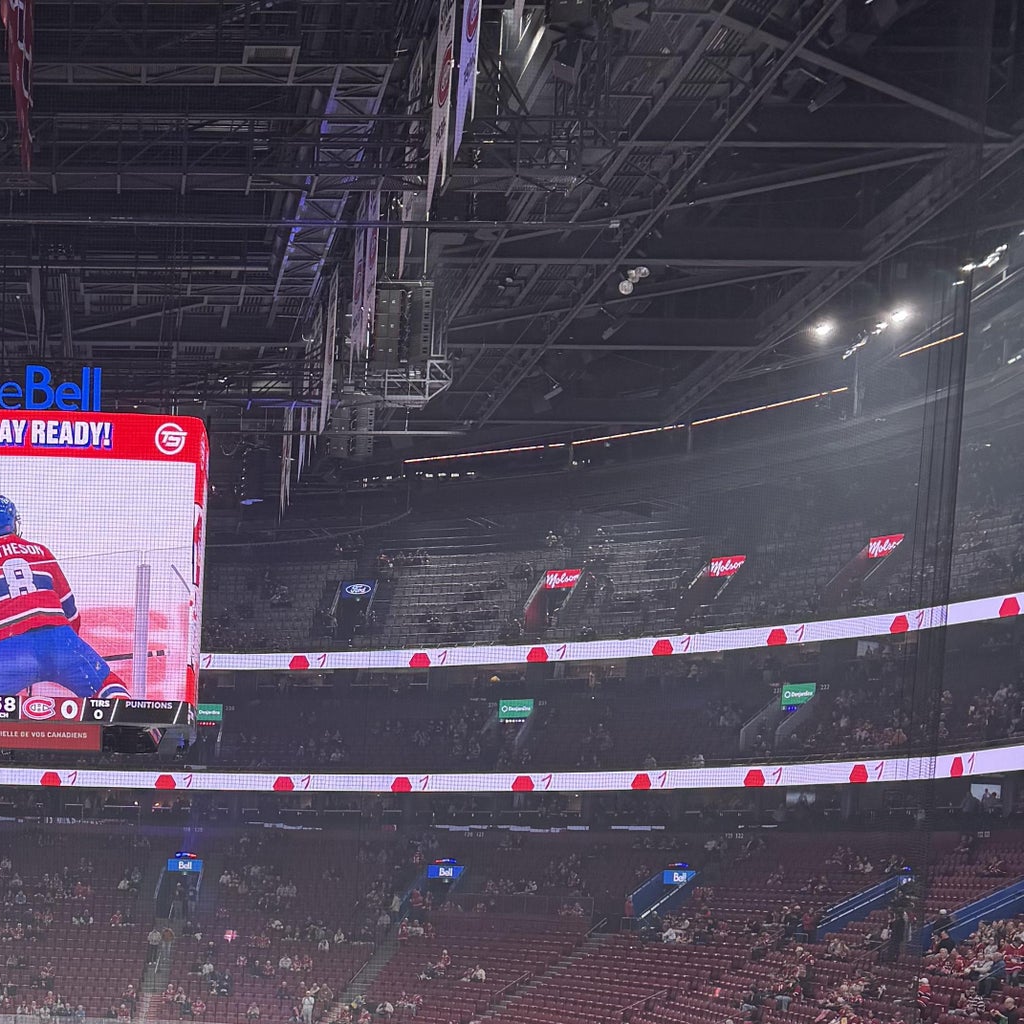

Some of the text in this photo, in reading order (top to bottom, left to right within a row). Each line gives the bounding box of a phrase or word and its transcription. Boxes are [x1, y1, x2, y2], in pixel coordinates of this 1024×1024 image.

[31, 421, 112, 447] READY!
[869, 538, 904, 557] Mols
[90, 700, 111, 708] TIRS
[125, 701, 173, 710] PUNITIONS
[60, 700, 76, 719] 0
[93, 708, 104, 720] 0
[47, 732, 88, 740] CANADIENS
[178, 861, 192, 870] Bell
[439, 867, 453, 876] Bell
[673, 872, 687, 882] Bell
